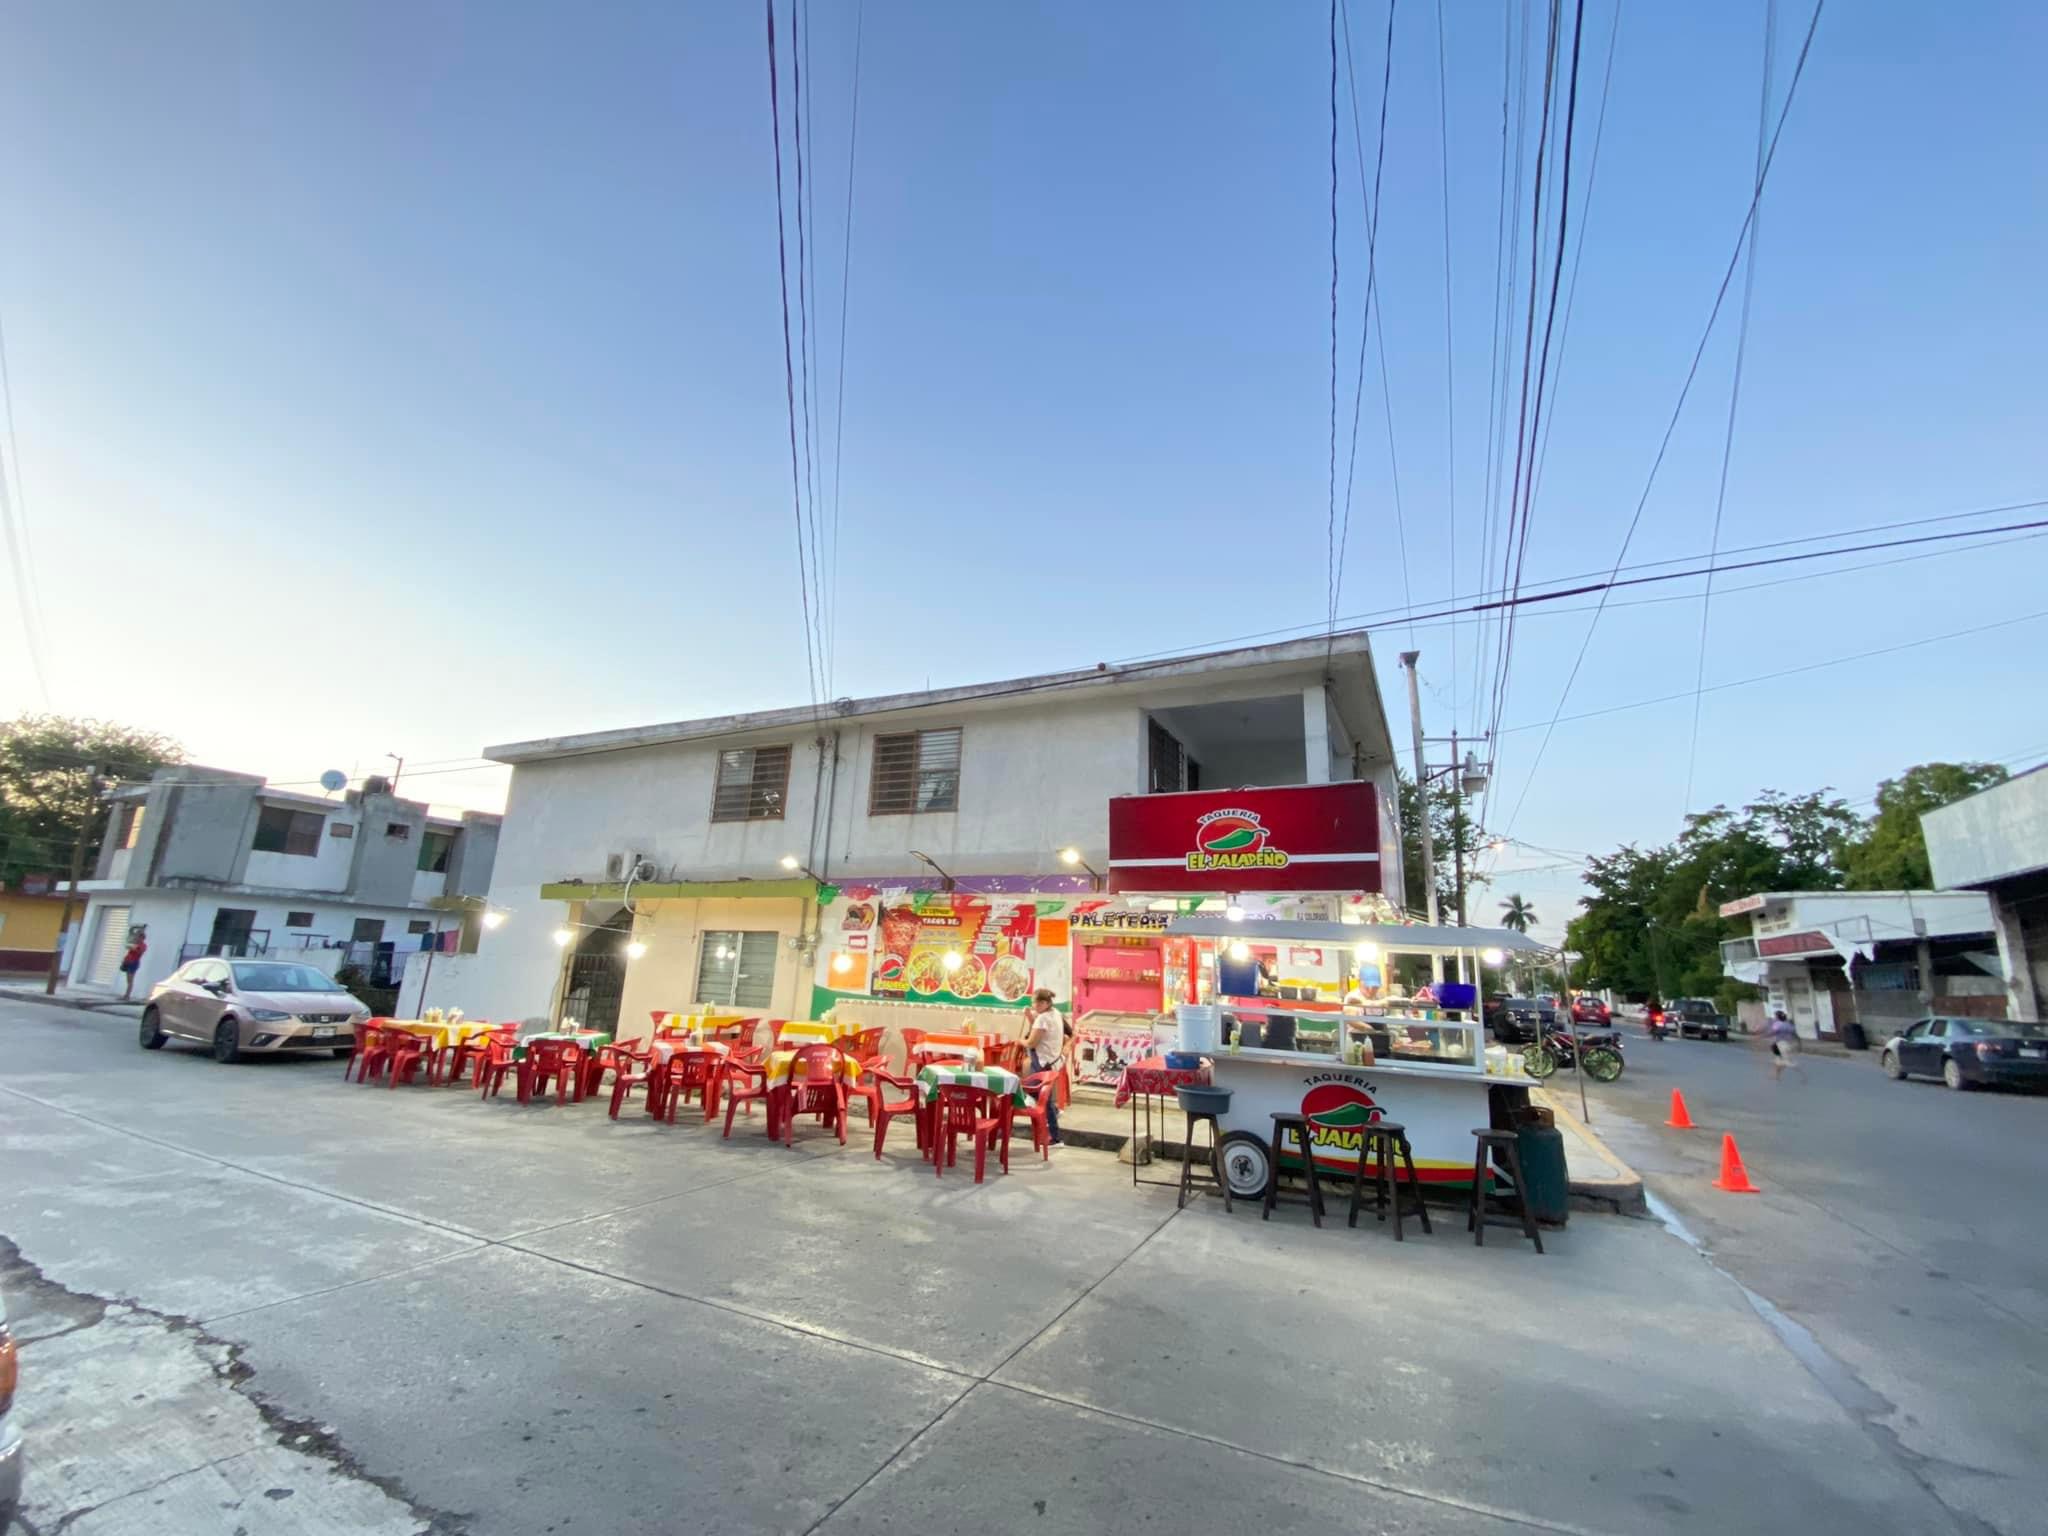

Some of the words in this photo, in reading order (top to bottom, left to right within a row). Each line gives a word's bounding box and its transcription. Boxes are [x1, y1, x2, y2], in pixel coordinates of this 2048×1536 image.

[1201, 809, 1260, 823] TAQUERIA
[1188, 853, 1205, 868] EL
[1209, 848, 1288, 868] JALAPEÑO
[1303, 1072, 1377, 1095] TAQUERIA
